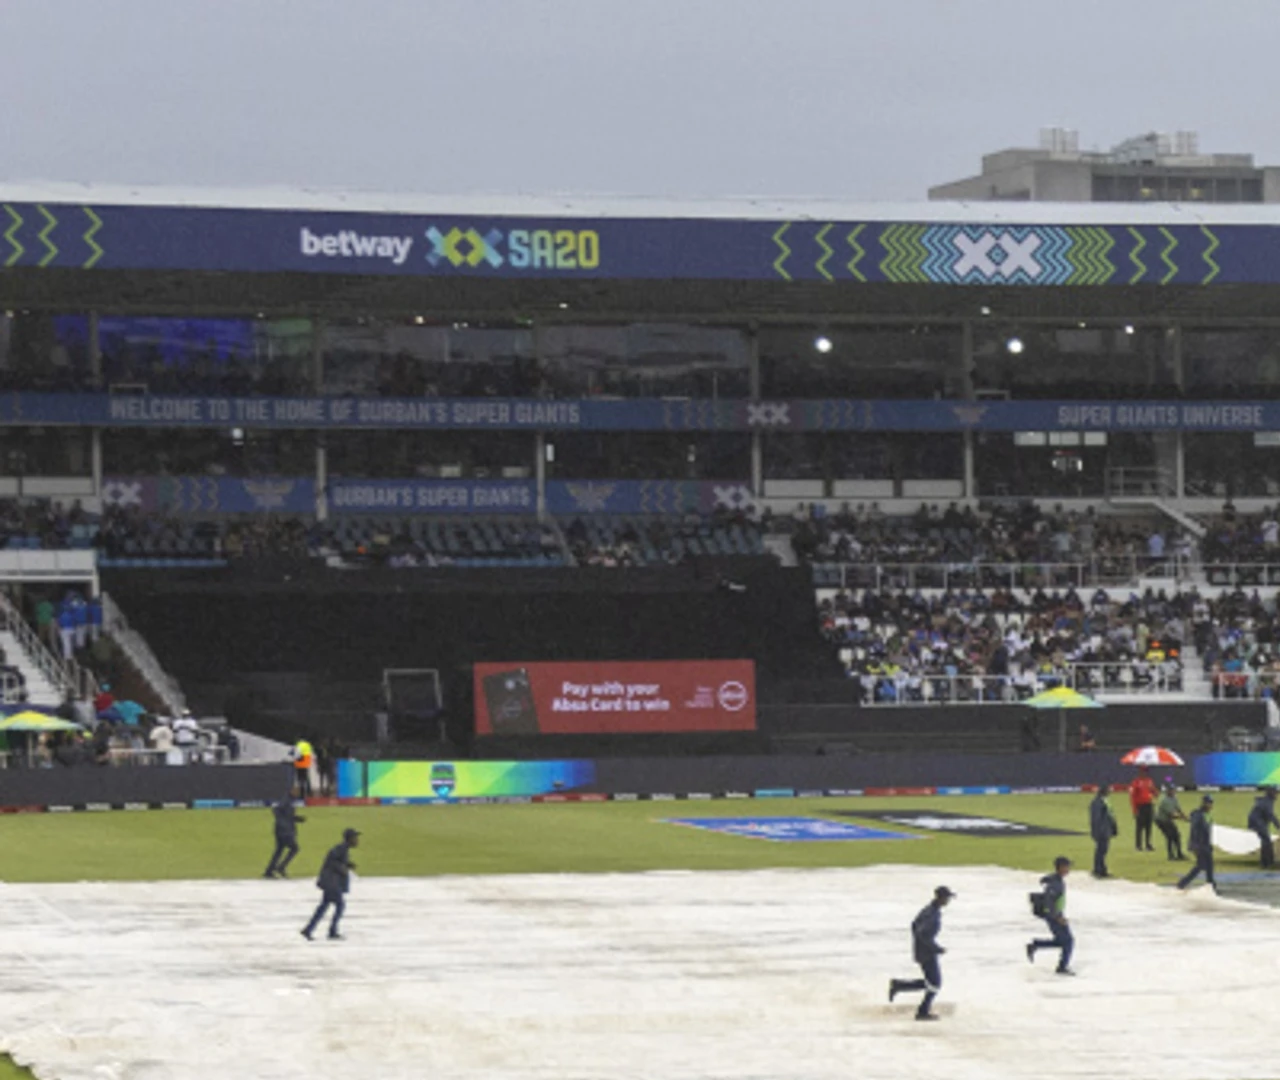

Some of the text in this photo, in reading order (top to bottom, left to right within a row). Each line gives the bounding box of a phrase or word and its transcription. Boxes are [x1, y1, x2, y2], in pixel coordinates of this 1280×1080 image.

[301, 227, 412, 264] betway
[508, 229, 599, 269] SA20
[111, 399, 580, 424] WELCOME TO THE HOME OF DURBAN'S SUPER GIANTS
[1058, 405, 1265, 427] SUPER GIANTS UNIVERSE
[333, 486, 530, 507] DURBAN'S SUPER GIANTS
[563, 681, 660, 698] Pay with your
[591, 698, 622, 711] Card
[626, 698, 641, 711] to
[644, 699, 670, 711] win
